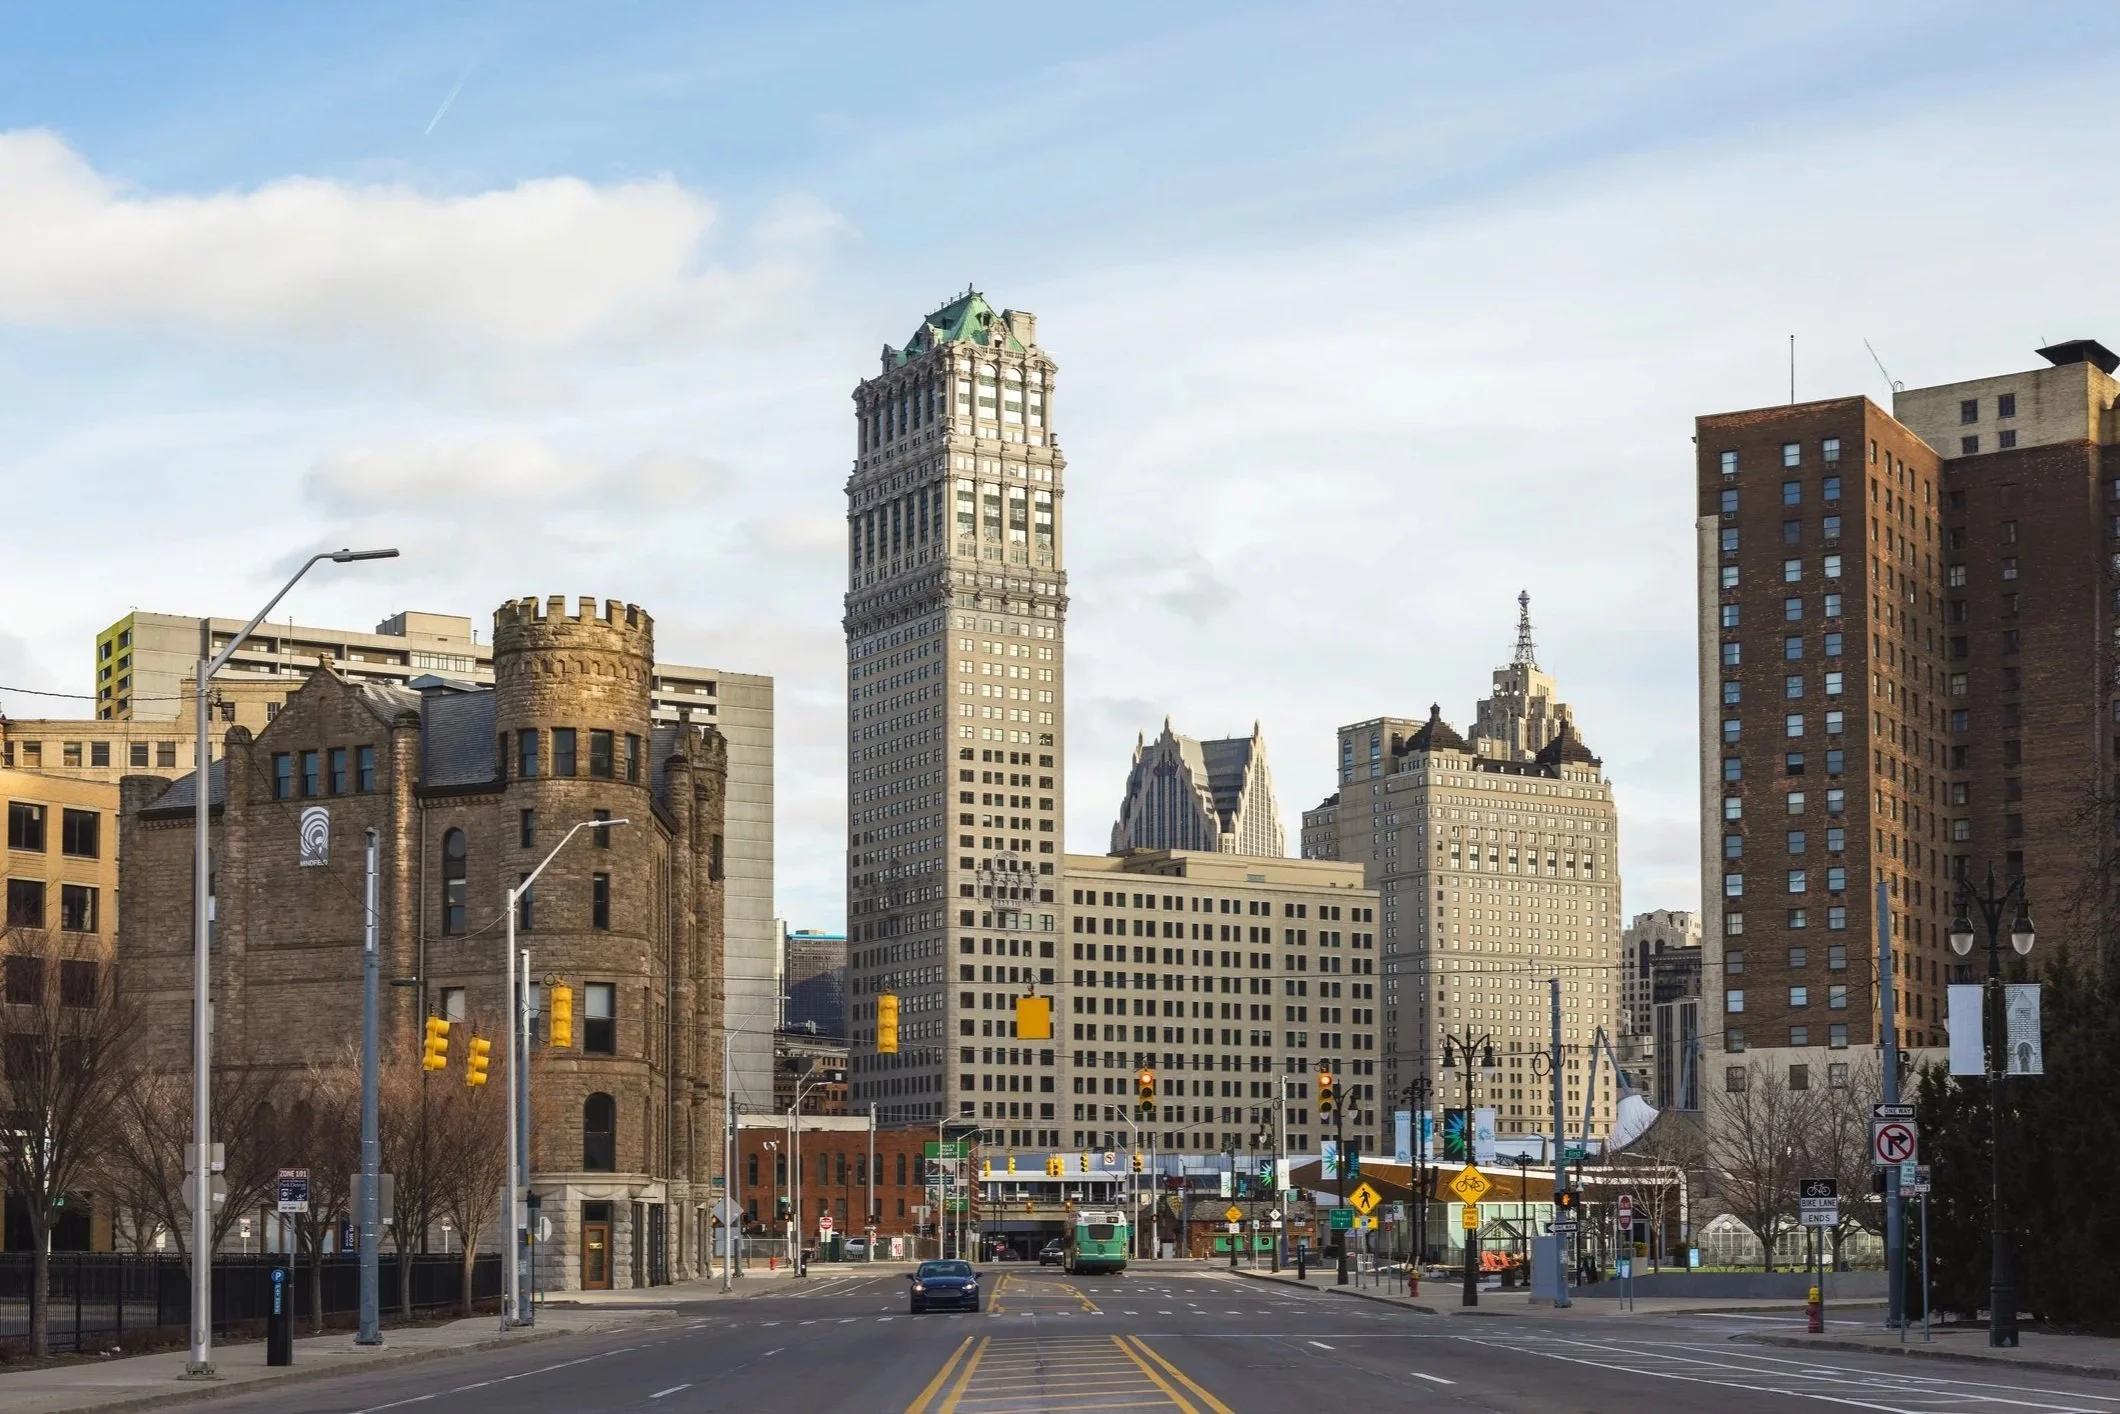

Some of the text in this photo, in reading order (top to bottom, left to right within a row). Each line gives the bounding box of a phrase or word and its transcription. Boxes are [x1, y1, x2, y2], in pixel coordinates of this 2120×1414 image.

[280, 1170, 307, 1178] ZONE 101
[1802, 1199, 1836, 1207] BIKE LANE
[1808, 1214, 1831, 1222] ENDS
[275, 1271, 281, 1280] P
